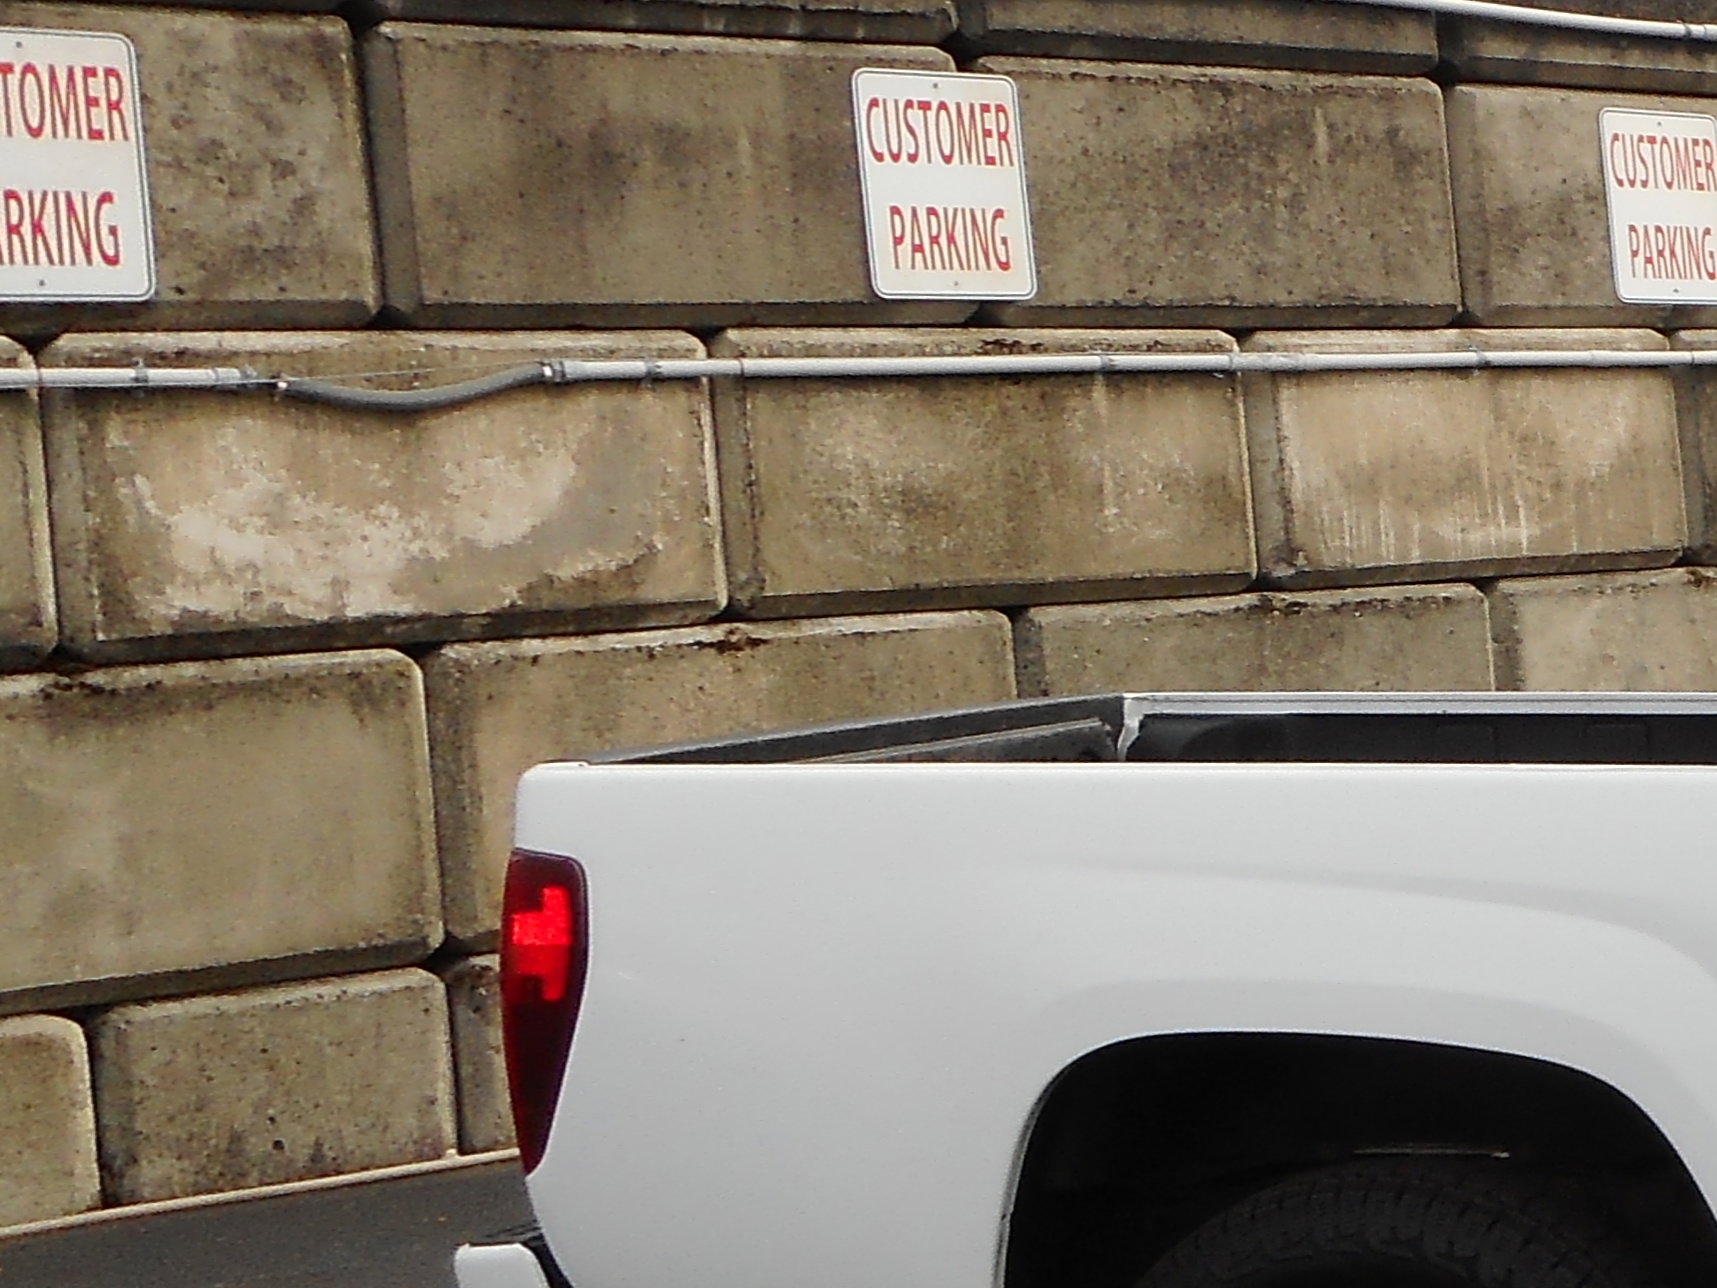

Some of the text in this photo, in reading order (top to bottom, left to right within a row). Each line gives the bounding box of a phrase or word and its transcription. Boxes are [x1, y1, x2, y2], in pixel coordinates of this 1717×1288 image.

[866, 97, 1015, 167] CUSTOMER
[0, 188, 121, 267] RKING
[888, 205, 1012, 272] PARKING
[1627, 223, 1717, 281] PARKING
